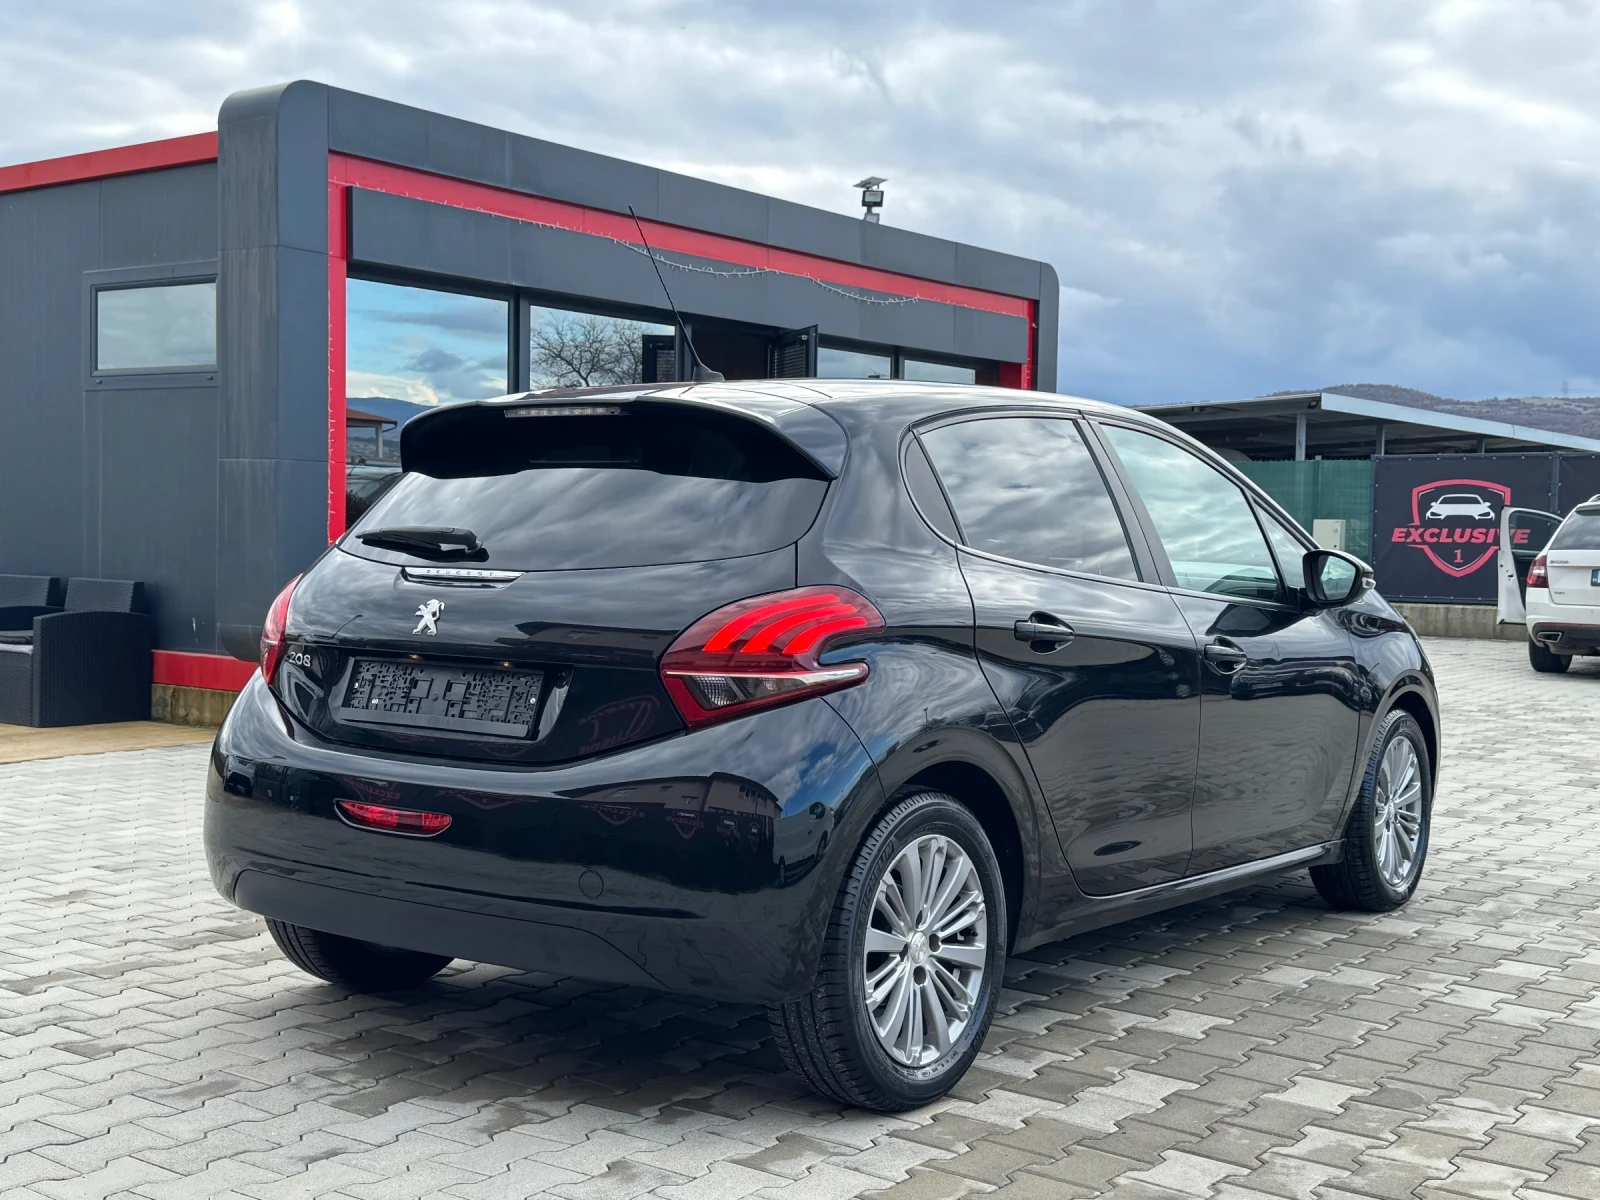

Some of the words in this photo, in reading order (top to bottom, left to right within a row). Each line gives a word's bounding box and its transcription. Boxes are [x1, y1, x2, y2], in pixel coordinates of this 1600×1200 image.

[1454, 549, 1464, 563] 1
[426, 569, 495, 577] PEUGEOT
[288, 651, 311, 667] 208
